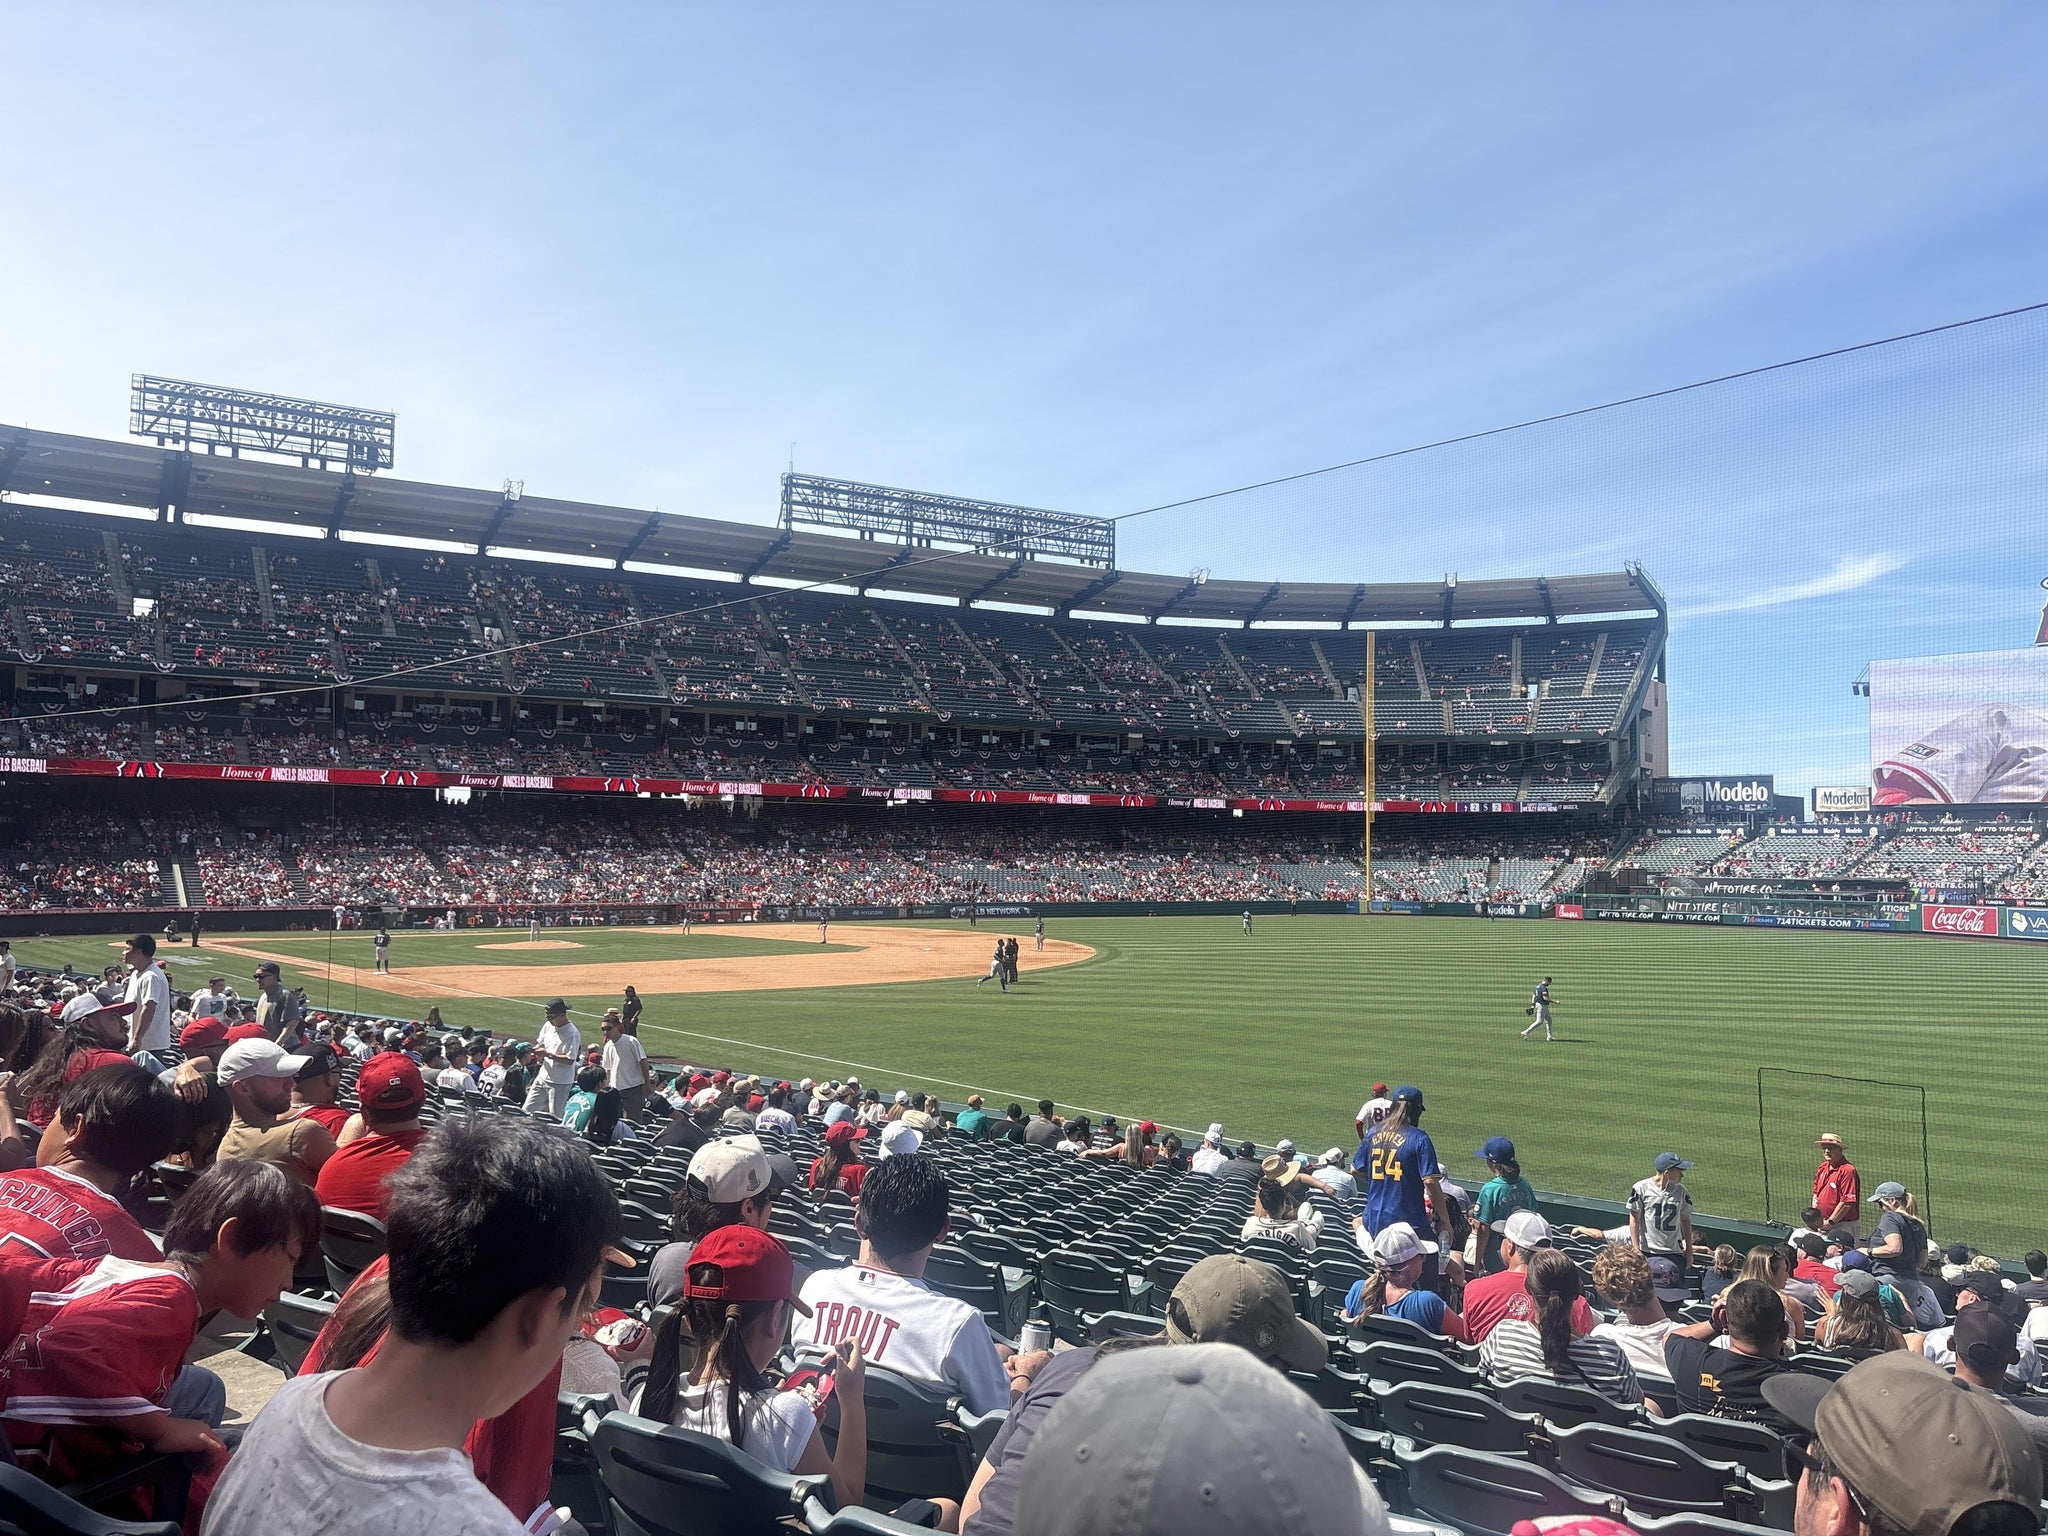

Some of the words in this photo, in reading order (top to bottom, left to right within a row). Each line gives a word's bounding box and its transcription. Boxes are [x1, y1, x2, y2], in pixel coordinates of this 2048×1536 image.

[11, 758, 47, 773] BASEBALL
[220, 766, 253, 778] Home
[254, 768, 267, 780] of
[271, 768, 296, 781] ANGELS
[297, 769, 329, 782] BASEBALL
[460, 774, 488, 786] Home
[488, 775, 500, 787] of
[503, 775, 525, 788] ANGELS
[526, 776, 554, 789] BASEBALL
[682, 782, 706, 792] Home
[706, 783, 716, 794] of
[718, 782, 738, 794] ANGELS
[738, 783, 762, 794] BASEBALL
[862, 788, 883, 798] Home
[883, 788, 892, 799] of
[894, 788, 910, 799] ANGELS
[911, 788, 932, 800] BASEBALL
[1705, 781, 1768, 801] Modelo
[1823, 791, 1863, 805] Modelo
[1363, 801, 1384, 811] BSEBALL
[986, 907, 1020, 915] NETWORK
[1621, 912, 1654, 920] TIRE.COM
[1685, 914, 1720, 922] TIRE.COM
[1776, 917, 1850, 928] 714TICKETS.COM
[1932, 907, 1987, 932] Coca-Cola
[1371, 1148, 1403, 1181] 24
[0, 1178, 113, 1259] CHANG
[1652, 1202, 1677, 1231] 12
[813, 1301, 900, 1362] TROUT
